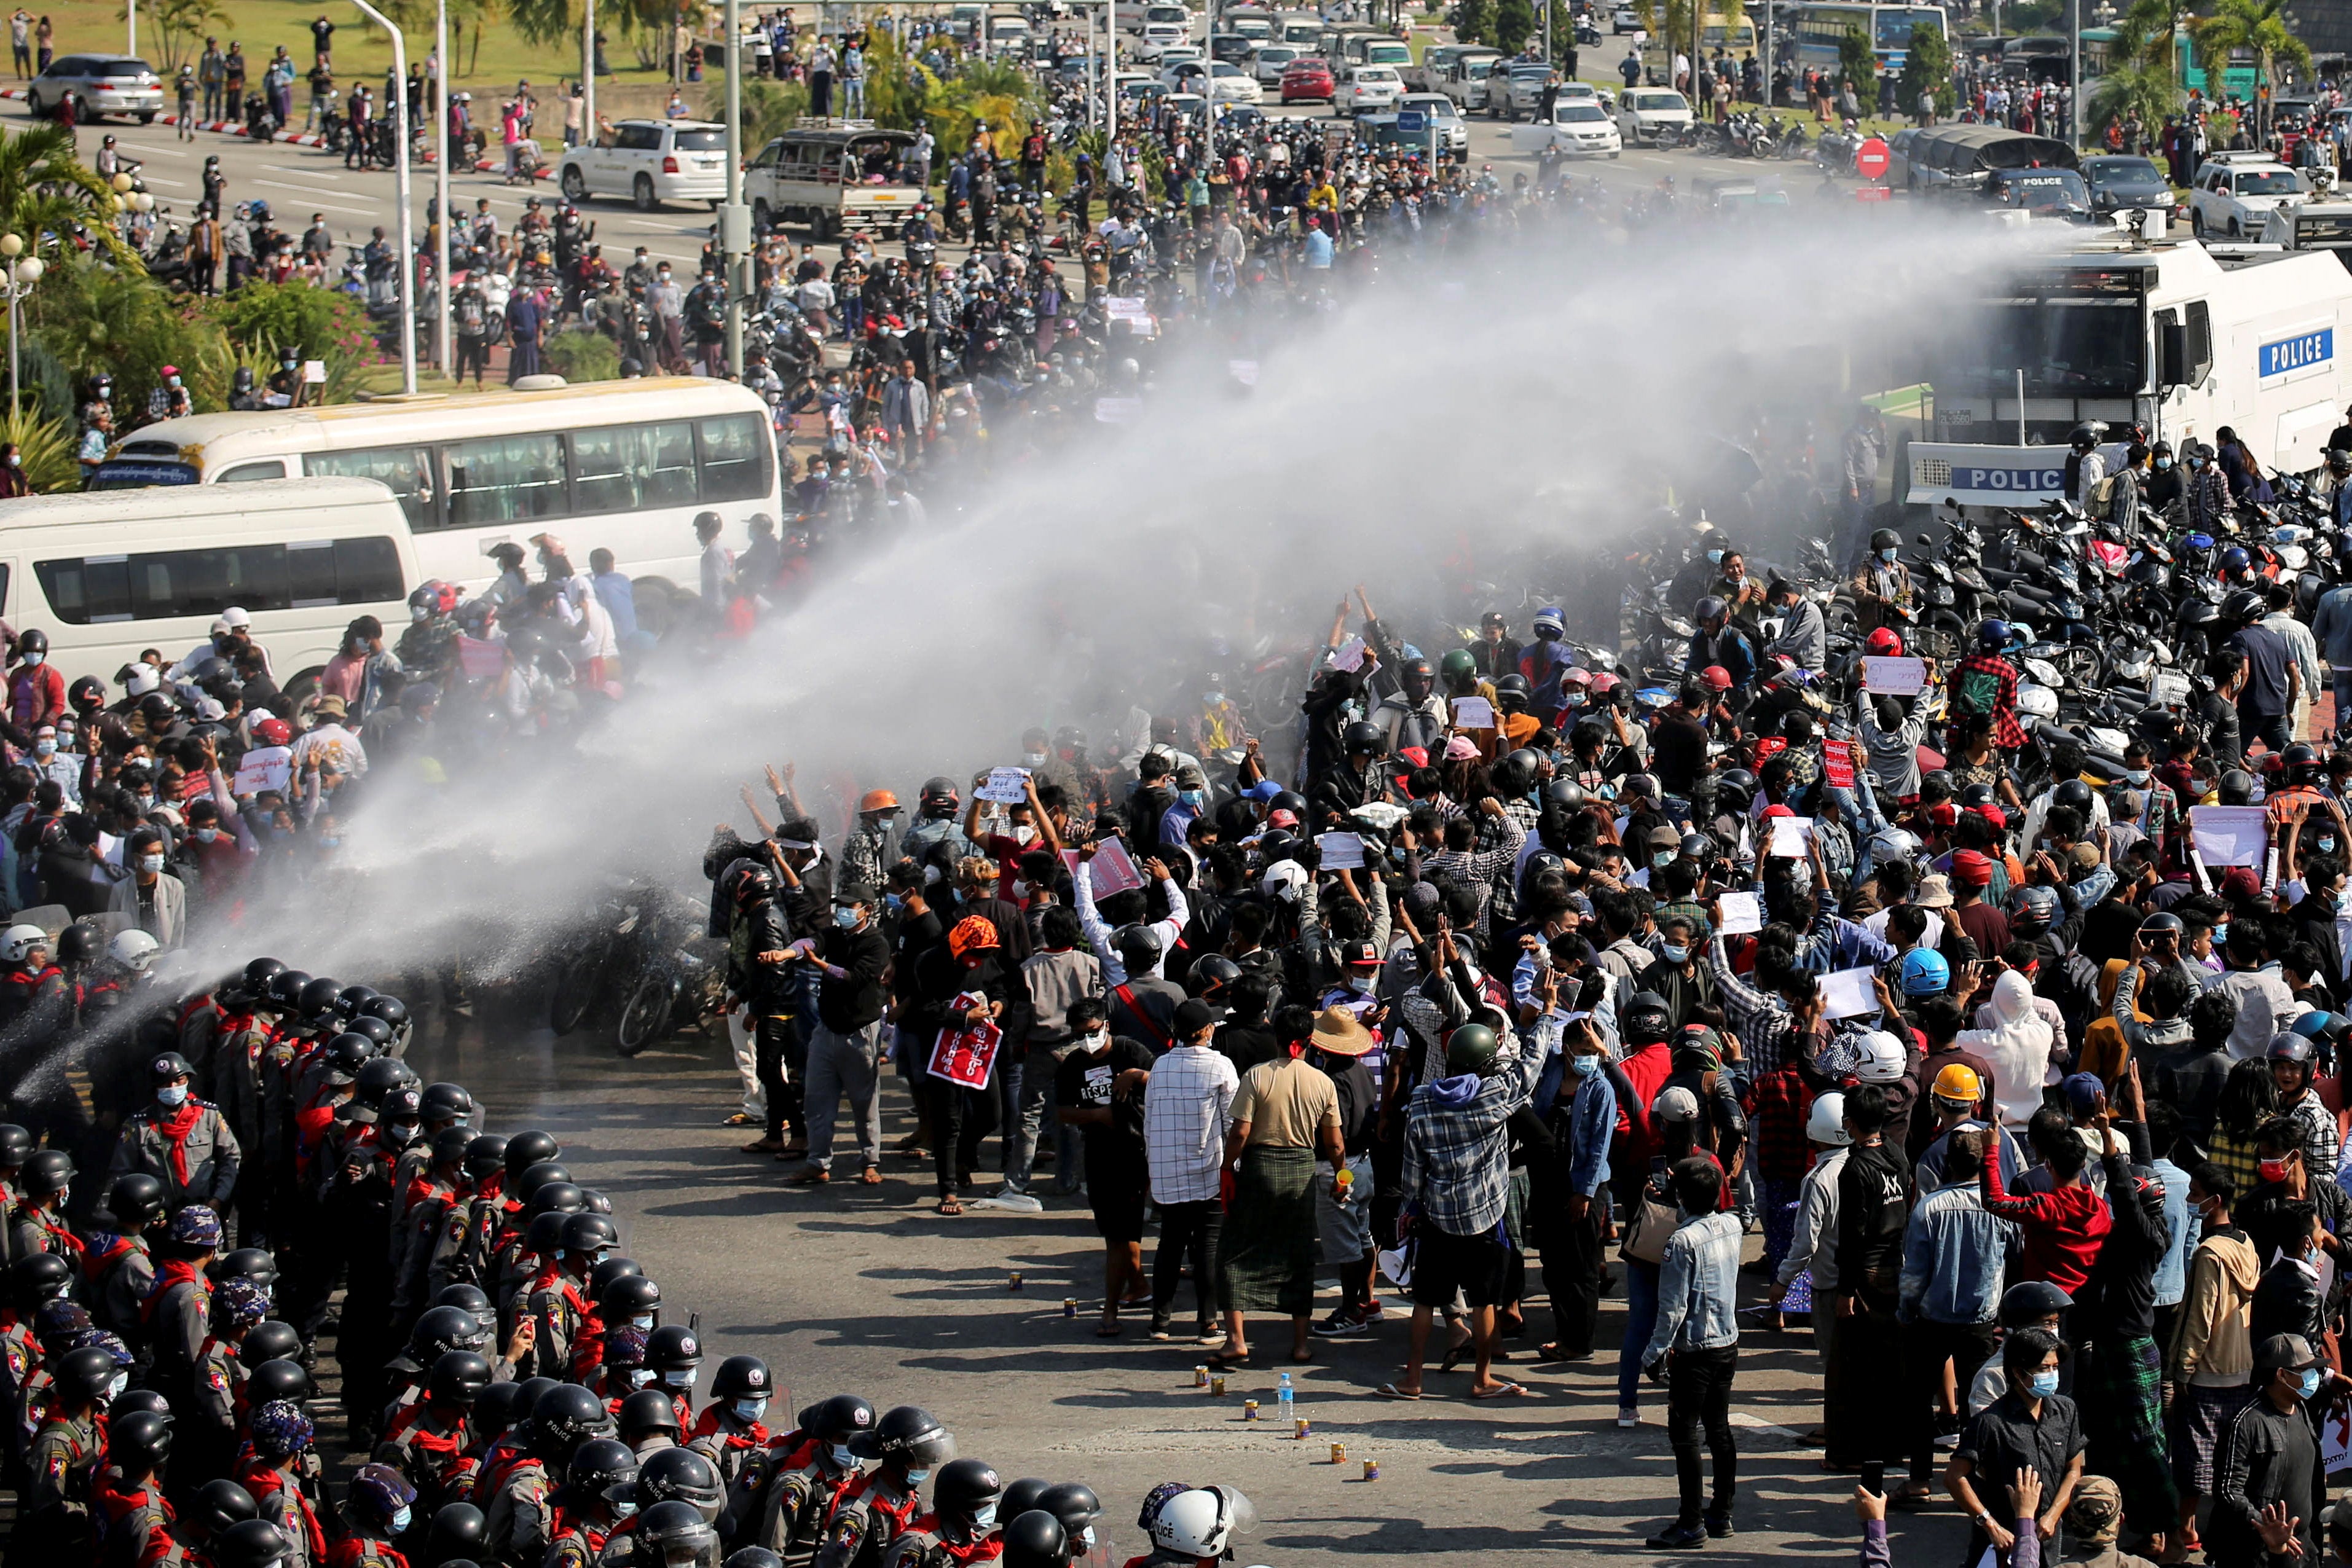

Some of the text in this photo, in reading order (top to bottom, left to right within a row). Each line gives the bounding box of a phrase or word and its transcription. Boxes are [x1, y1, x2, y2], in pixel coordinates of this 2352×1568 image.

[2271, 335, 2321, 372] POLICE
[1972, 469, 2059, 490] POLIC
[269, 992, 286, 1002] OLICE
[337, 996, 352, 1008] OLICE
[1081, 1084, 1113, 1100] RESPE
[435, 1339, 454, 1354] POLI
[546, 1420, 572, 1441] POLICE
[645, 1476, 664, 1501] POLICE
[1157, 1524, 1174, 1539] LICE
[635, 1534, 654, 1554] POLICE
